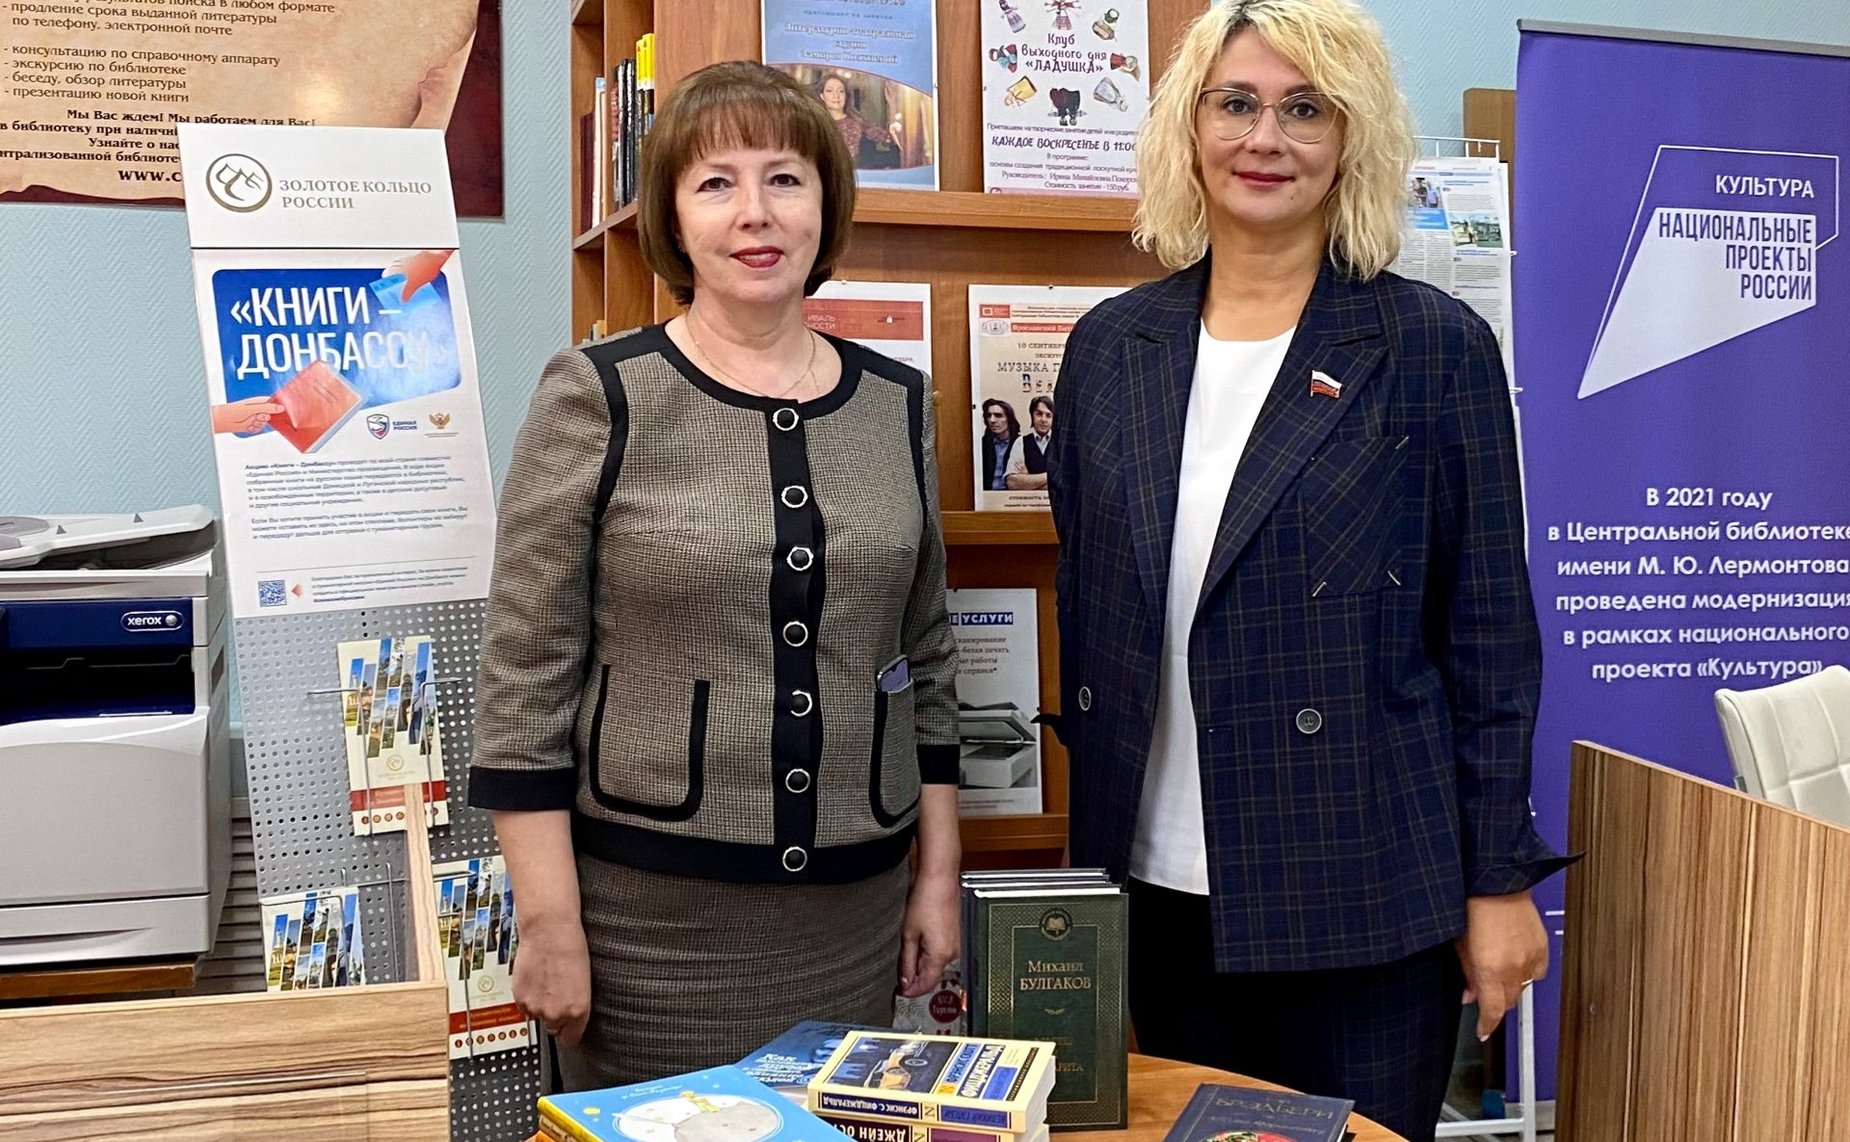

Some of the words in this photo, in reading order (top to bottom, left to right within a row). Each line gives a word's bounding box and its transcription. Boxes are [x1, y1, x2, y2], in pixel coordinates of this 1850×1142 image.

[11, 3, 84, 15] продление
[88, 7, 127, 18] срока
[132, 10, 197, 20] выданной
[201, 12, 277, 25] литературы
[231, 0, 274, 10] любом
[278, 2, 335, 13] формате
[12, 17, 29, 26] по
[34, 18, 100, 31] телефону,
[104, 22, 190, 34] электронной
[195, 26, 233, 36] почте
[1048, 33, 1075, 48] Клуб
[12, 45, 107, 58] консультацию
[111, 50, 128, 59] по
[132, 51, 217, 65] справочному
[221, 55, 280, 67] аппарату
[1022, 44, 1082, 62] выходного
[1087, 51, 1107, 62] дня
[12, 59, 84, 72] экскурсию
[88, 64, 105, 72] по
[109, 61, 186, 75] библиотеке
[1026, 60, 1104, 74] «ЛАДУШКА»
[12, 72, 61, 86] беседу,
[66, 74, 106, 87] обзор
[109, 78, 186, 90] литературы
[13, 87, 102, 100] презентацию
[106, 91, 146, 101] новой
[150, 94, 189, 102] книги
[67, 110, 89, 120] Мы
[94, 110, 118, 120] Вас
[122, 112, 164, 123] ждем!
[168, 114, 190, 123] Мы
[194, 114, 257, 126] работаем
[260, 118, 284, 126] для
[288, 118, 316, 126] Вас!
[12, 120, 92, 136] библиотеку
[96, 126, 121, 137] при
[987, 122, 1024, 132] Приглашаем
[88, 138, 142, 149] Узнайте
[992, 136, 1034, 148] КАЖДОЕ
[1036, 138, 1100, 150] ВОСКРЕСЕНЬЕ
[1102, 140, 1110, 151] В
[0, 150, 112, 162] нтрализованной
[1045, 163, 1091, 172] традиционной
[118, 170, 183, 182] www.c
[280, 179, 360, 192] ЗОЛОТОЕ
[363, 180, 432, 194] КОЛЬЦО
[1044, 181, 1076, 190] Стоимость
[1716, 174, 1814, 198] КУЛЬТУРА
[282, 197, 354, 209] РОССИИ
[1658, 212, 1812, 244] НАЦИОНАЛЬНЫЕ
[1726, 244, 1812, 272] ПРОЕКТЫ
[1740, 274, 1812, 300] РОССИИ
[230, 286, 370, 326] «КНИГИ
[808, 314, 836, 322] ИВАЛЬ
[998, 362, 1050, 373] МУЗЫКА
[1646, 488, 1660, 506] В
[1666, 488, 1715, 506] 2021
[1722, 492, 1773, 510] году
[1548, 526, 1560, 541] в
[1566, 521, 1720, 545] Центральной
[1726, 522, 1850, 541] библиотеке
[1557, 560, 1632, 576] имени
[1637, 556, 1666, 576] М.
[1672, 556, 1704, 576] Ю.
[1708, 556, 1850, 578] Лермонтова
[1556, 594, 1686, 615] проведена
[1692, 592, 1850, 613] модернизация
[127, 616, 162, 626] xerox
[962, 614, 1013, 624] УСЛУГИ
[1563, 630, 1576, 646] в
[1582, 629, 1672, 650] рамках
[1678, 626, 1850, 644] национального
[1592, 661, 1692, 683] проекта
[1696, 658, 1823, 680] «Культура»
[1028, 960, 1084, 974] Михаил
[1020, 976, 1092, 992] БУЛГАКОВ
[823, 1095, 878, 1110] ФИЦДЖЕРАЛЬД
[878, 1102, 886, 1111] С.
[886, 1102, 918, 1114] ФРЭНСИС
[858, 1124, 906, 1142] ДЖЕЙН
